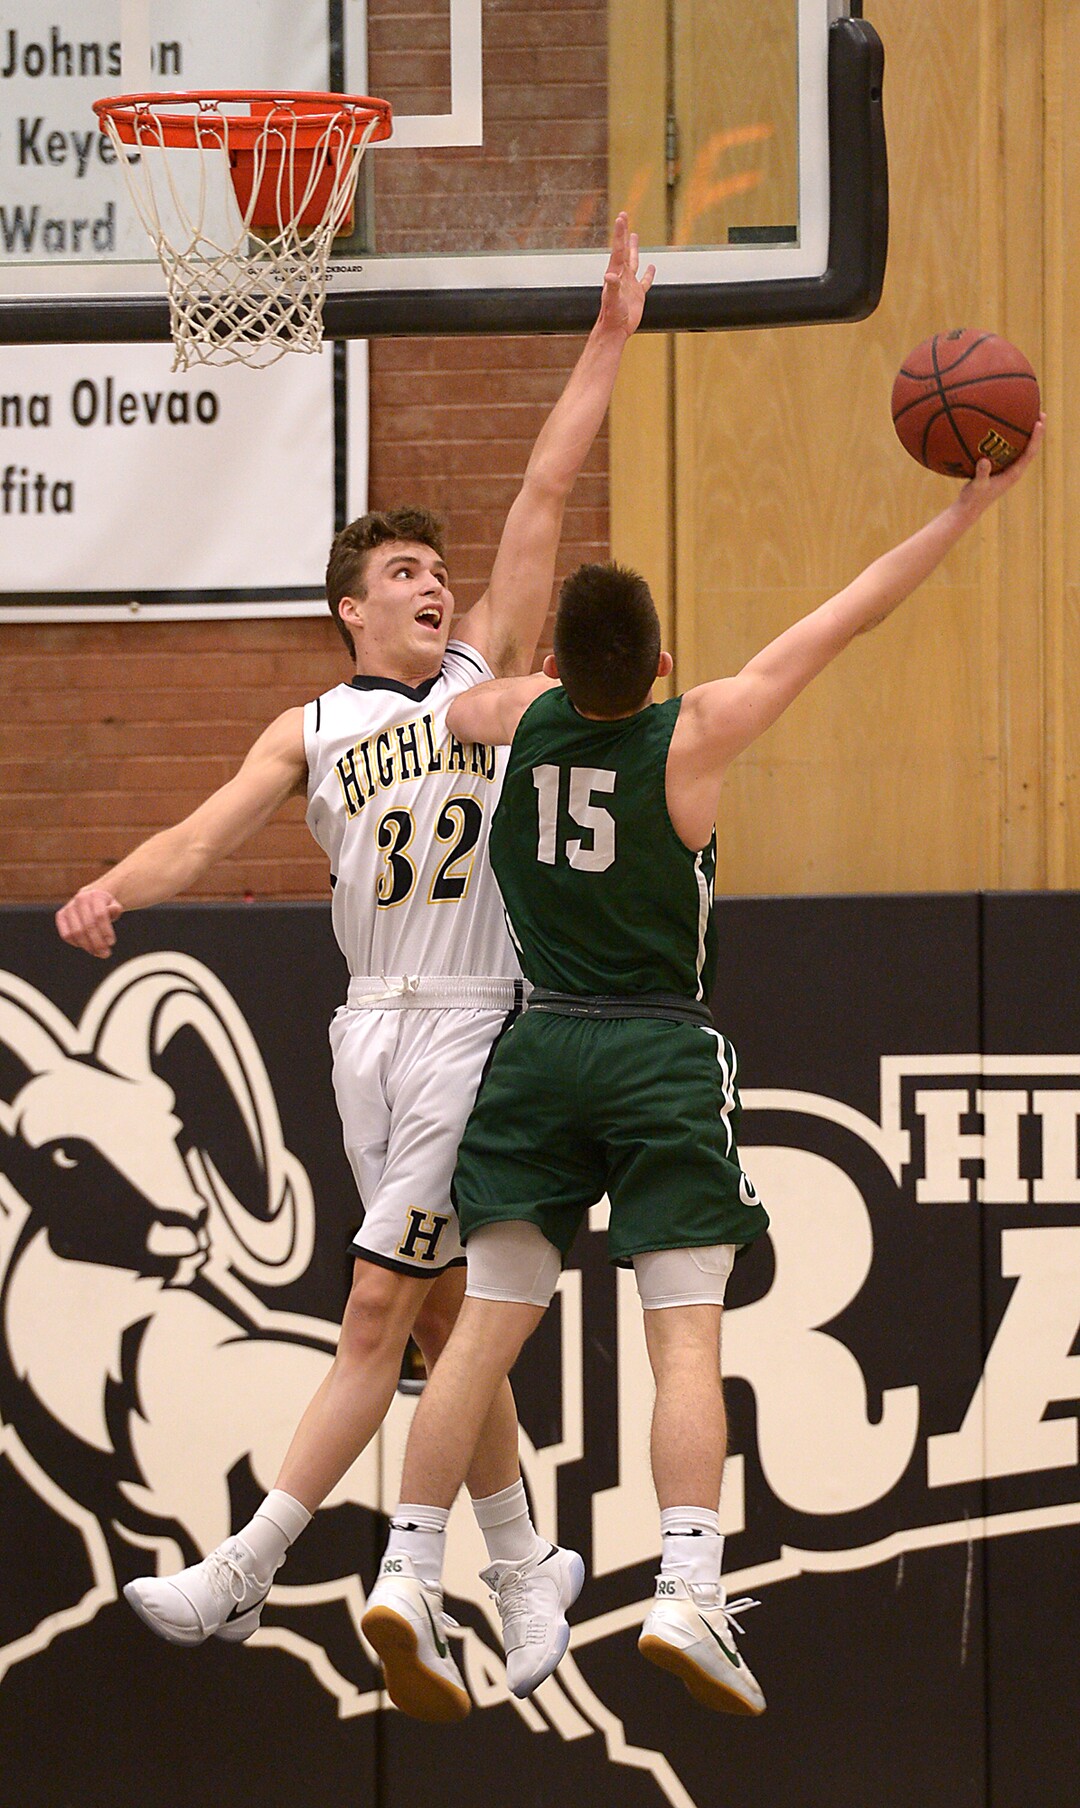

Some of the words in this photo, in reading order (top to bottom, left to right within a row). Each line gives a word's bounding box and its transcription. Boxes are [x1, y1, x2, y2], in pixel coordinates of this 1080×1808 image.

[1, 26, 182, 78] Johnsn
[0, 201, 116, 253] Ward
[313, 265, 363, 273] BCKBOARD
[72, 377, 219, 427] Olevao
[0, 464, 74, 514] fita
[334, 711, 497, 820] HIGHLAND
[531, 763, 617, 873] 15
[375, 793, 485, 910] 32
[395, 1205, 451, 1264] H
